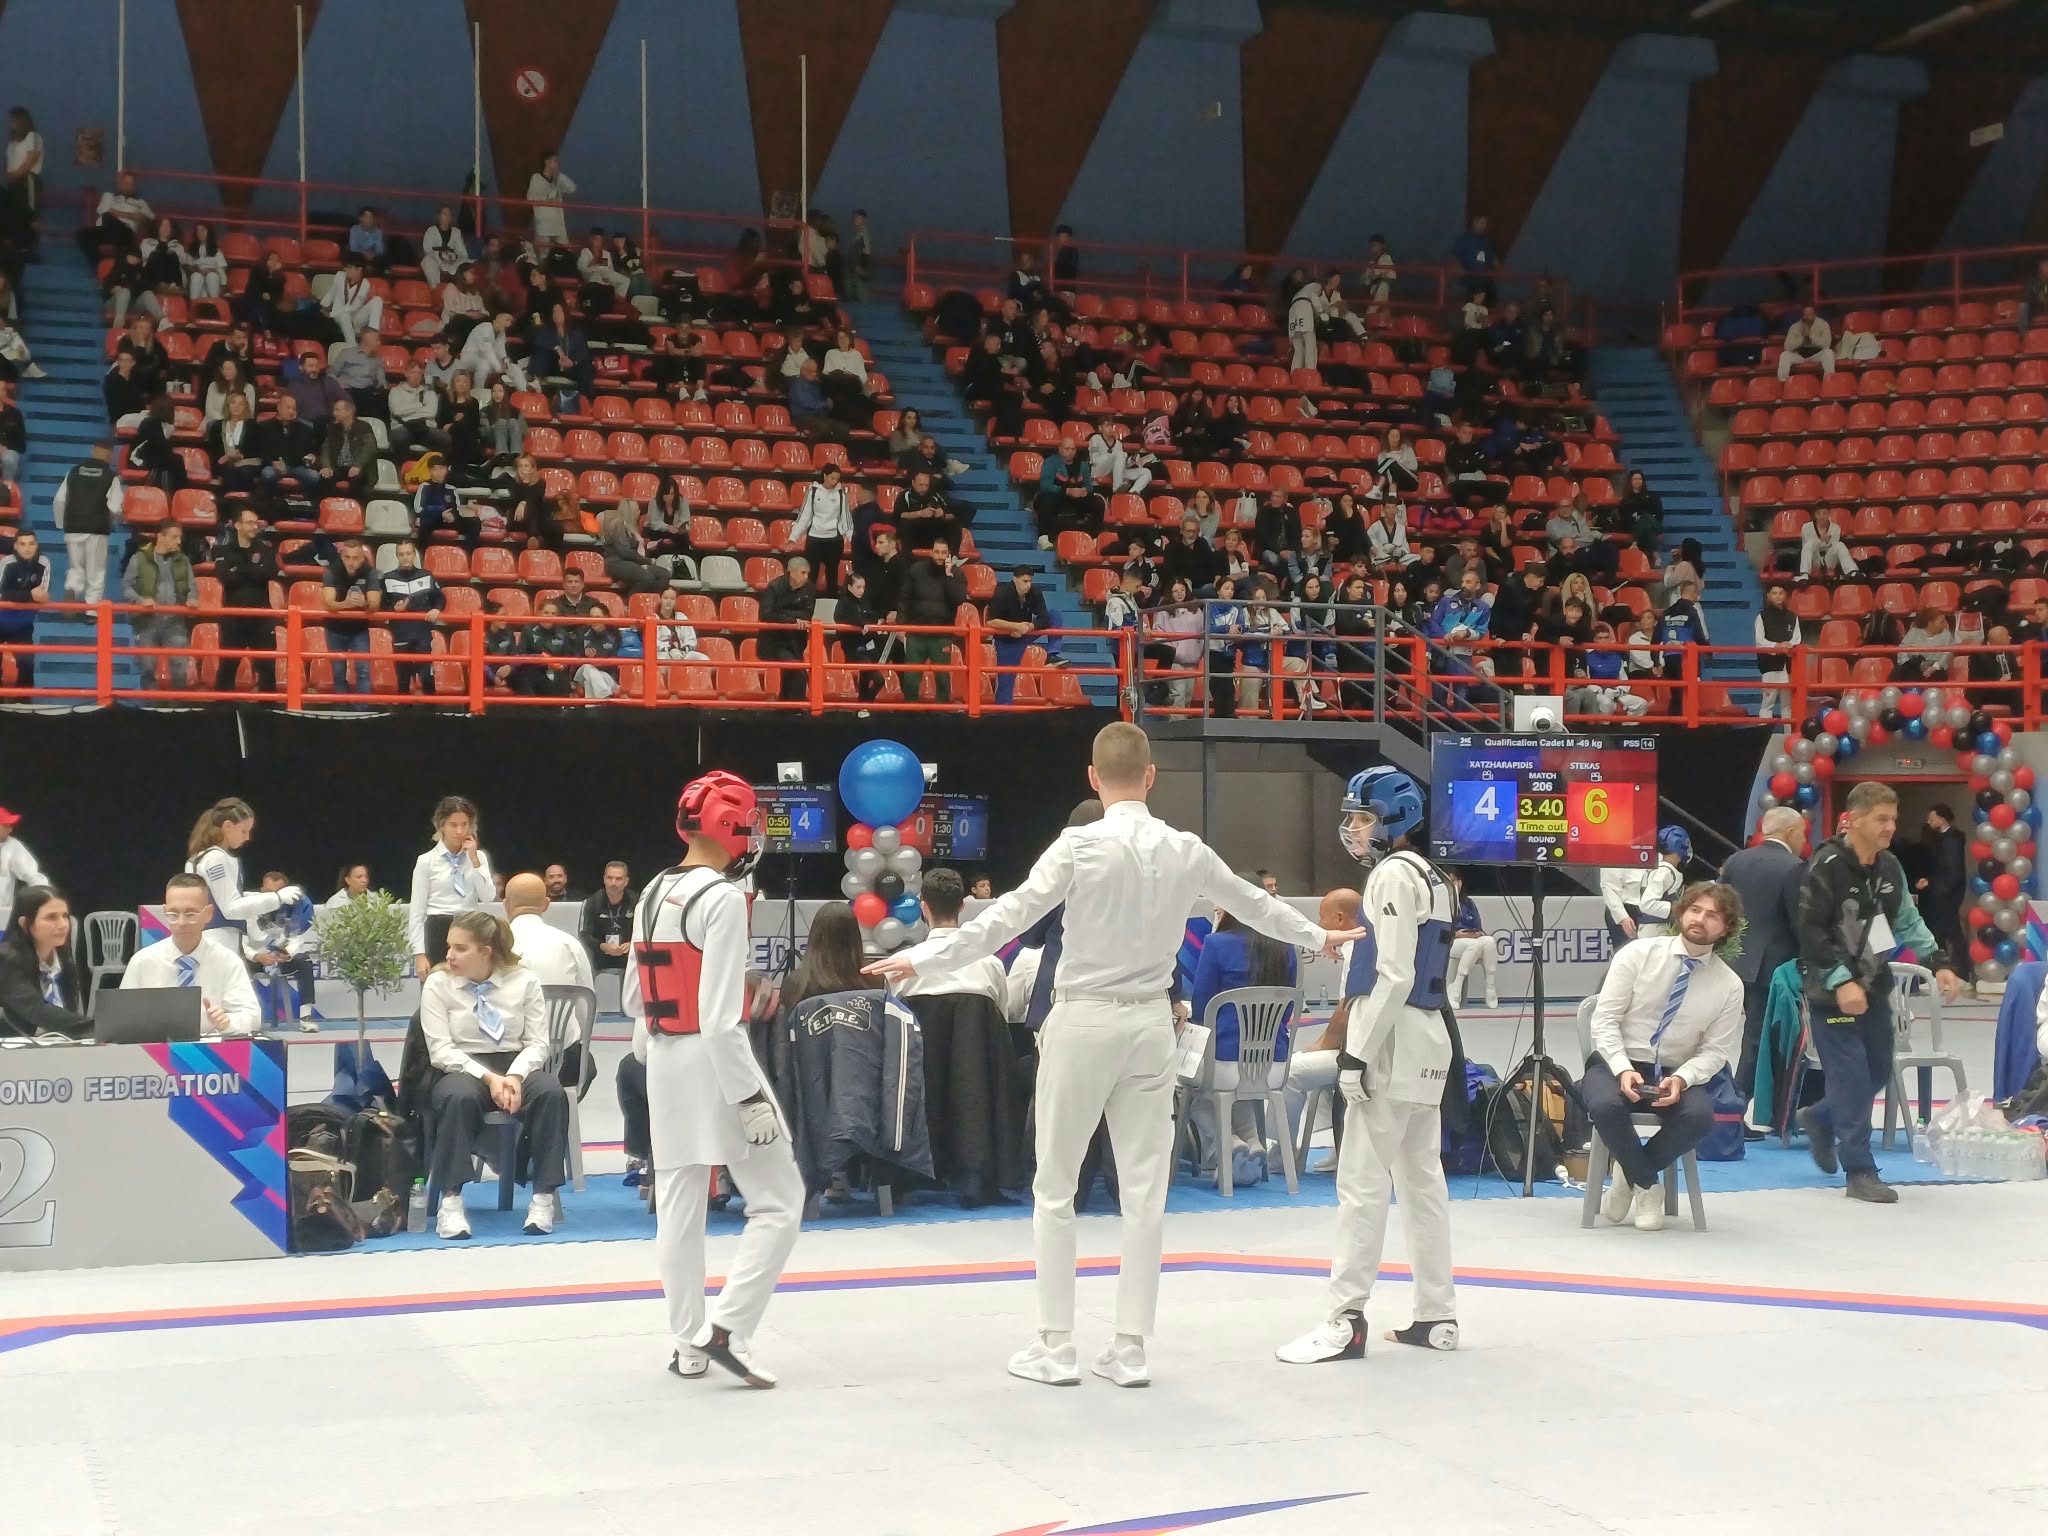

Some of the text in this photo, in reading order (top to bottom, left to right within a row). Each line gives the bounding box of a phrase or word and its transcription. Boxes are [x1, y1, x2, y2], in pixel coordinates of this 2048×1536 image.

[1484, 738, 1603, 750] Qualification Cadet M -49 kg
[1623, 739, 1640, 748] PSS
[1569, 762, 1600, 770] STEKAS
[1528, 772, 1557, 780] MATCH
[1532, 781, 1553, 792] 206
[1474, 785, 1500, 821] 4
[1520, 798, 1564, 817] 3.40
[1583, 788, 1609, 824] 6
[768, 816, 789, 827] 0:50
[797, 810, 811, 830] 4
[915, 816, 926, 836] 0
[959, 818, 969, 837] 0
[1505, 824, 1514, 836] 2
[1518, 821, 1565, 832] Time out
[1570, 826, 1579, 837] 3
[1528, 835, 1556, 844] ROUND
[1439, 846, 1448, 857] 3
[1536, 846, 1548, 861] 2
[1640, 851, 1649, 862] 0
[84, 1073, 240, 1101] FEDERATION
